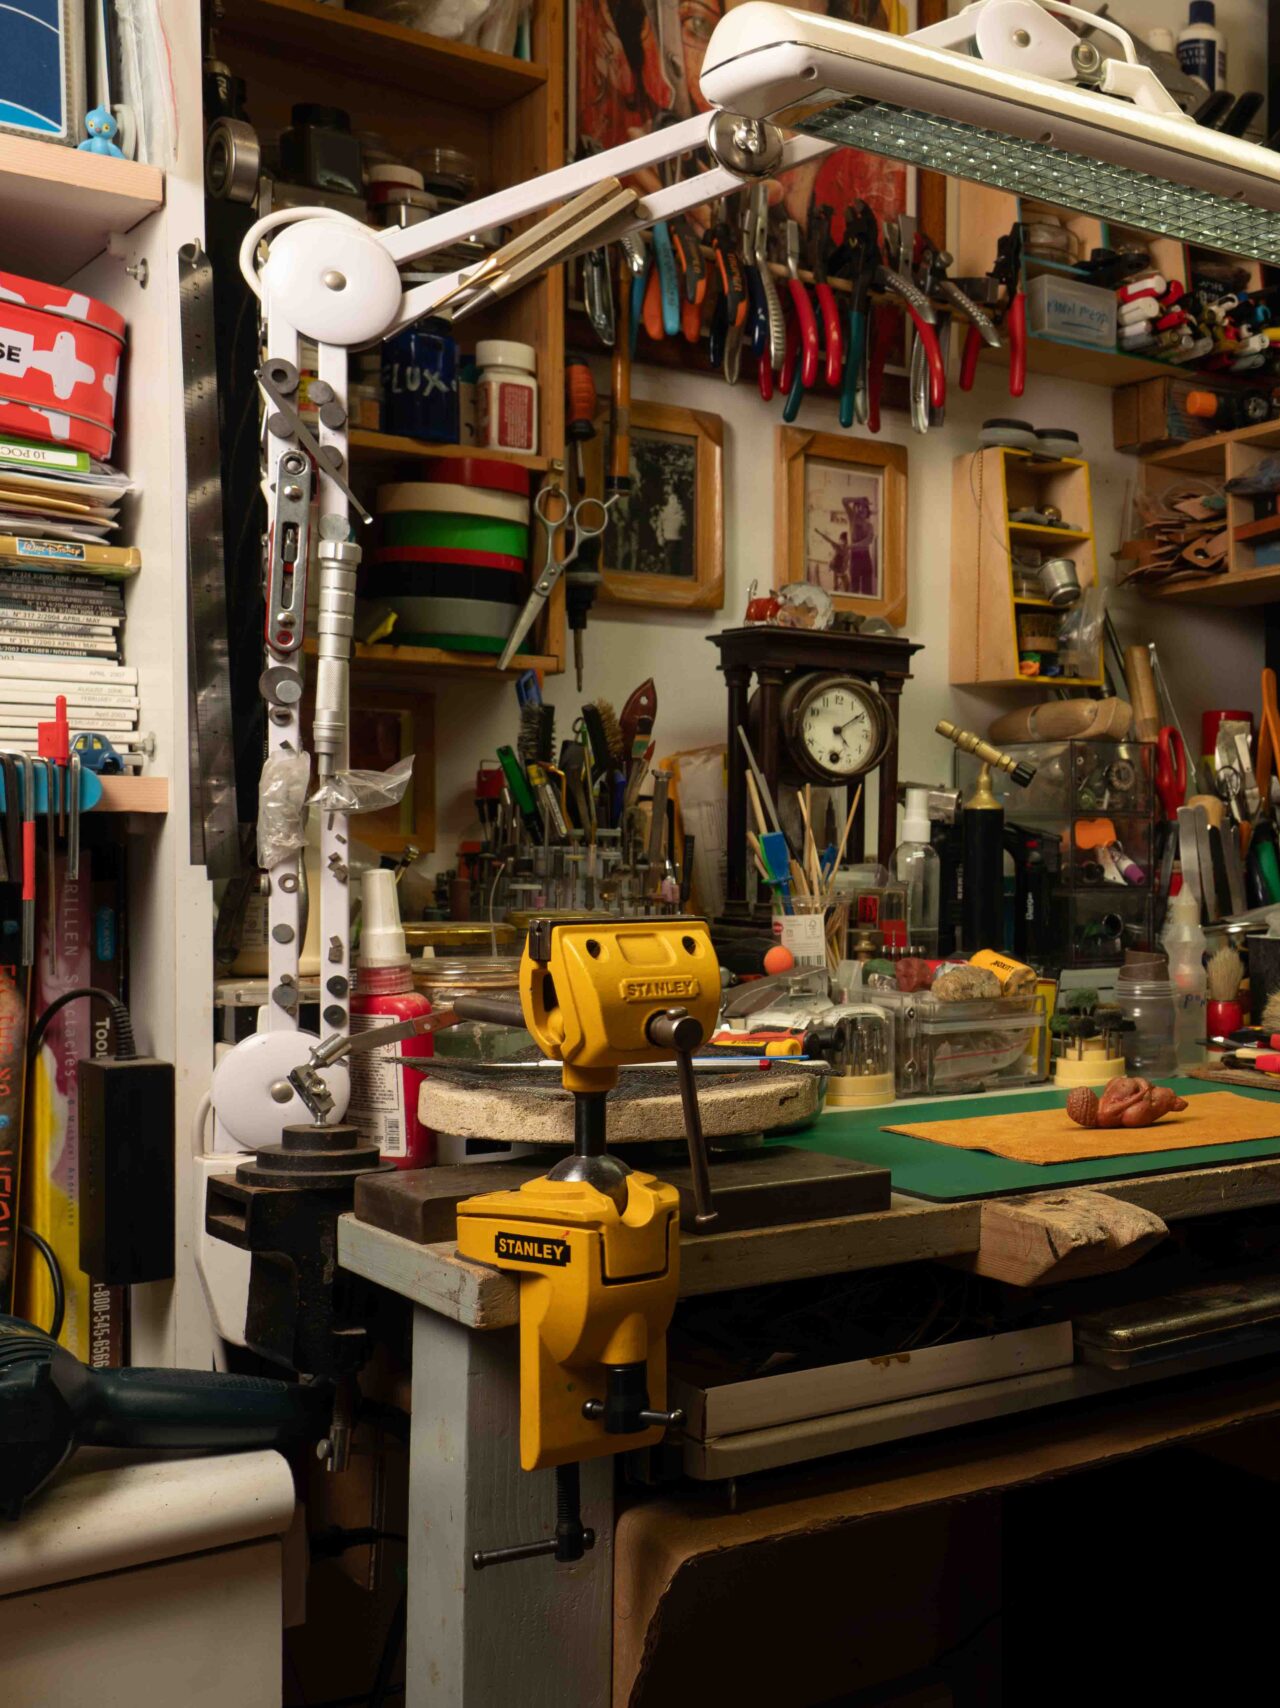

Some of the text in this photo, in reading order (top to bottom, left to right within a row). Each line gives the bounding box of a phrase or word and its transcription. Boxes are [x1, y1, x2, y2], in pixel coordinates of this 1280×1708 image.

[33, 451, 46, 461] 10
[835, 695, 844, 705] 12
[626, 979, 694, 996] STANLEY
[63, 974, 79, 1077] Sctacles
[498, 1237, 565, 1260] STANLEY
